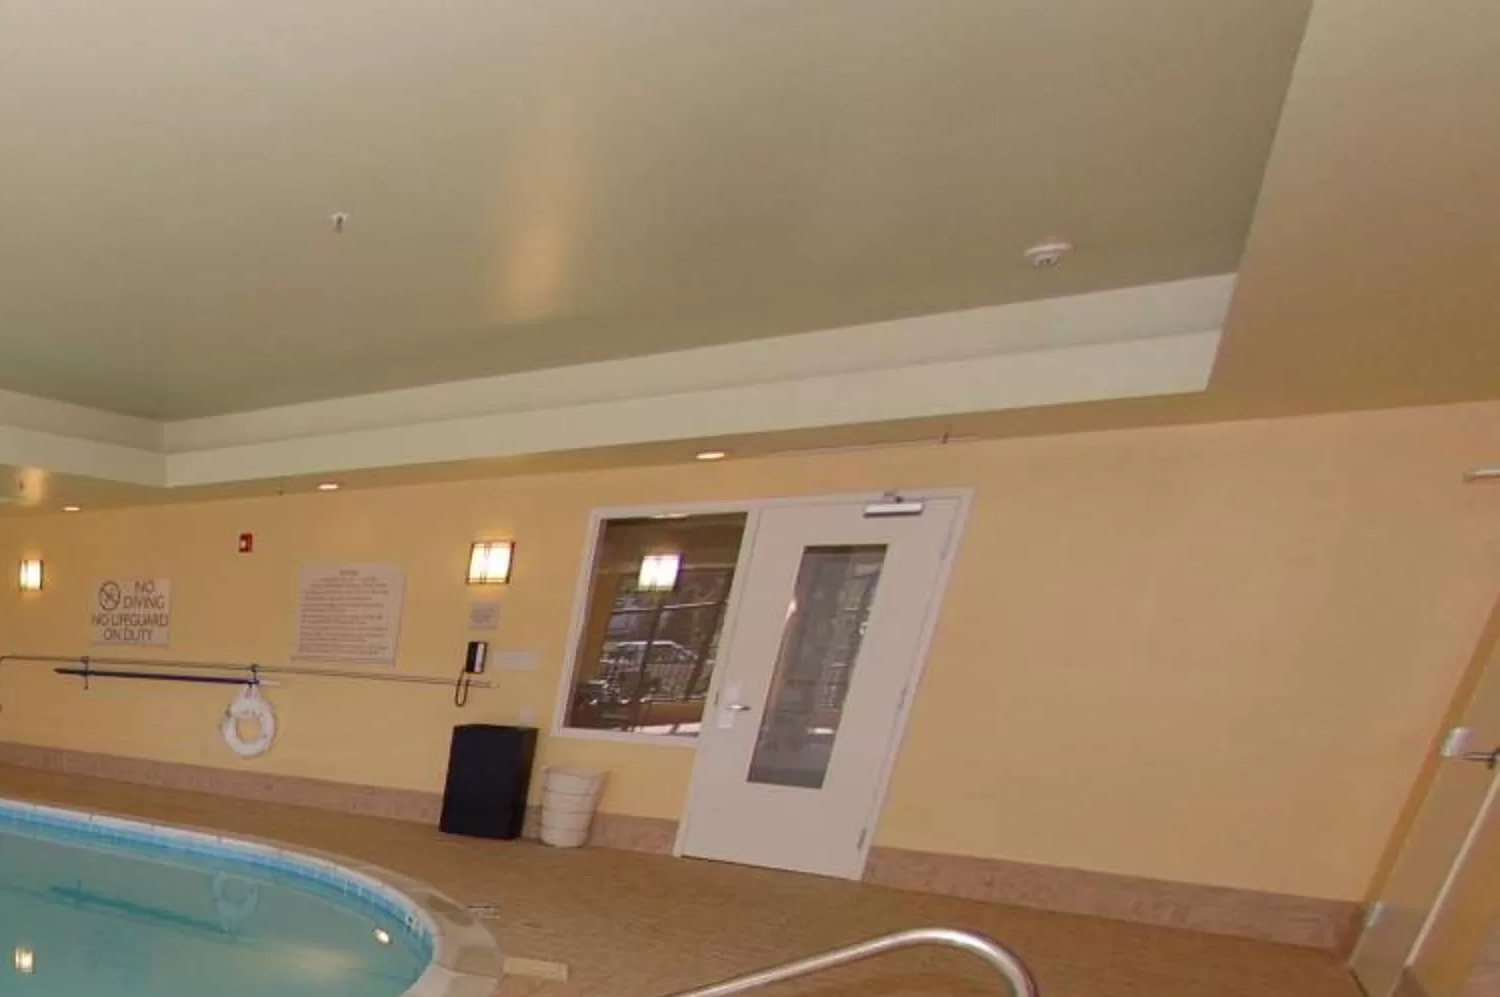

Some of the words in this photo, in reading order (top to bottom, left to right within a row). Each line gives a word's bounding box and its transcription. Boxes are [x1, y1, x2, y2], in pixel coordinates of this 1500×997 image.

[134, 580, 155, 593] NO
[123, 594, 165, 609] DIVING
[92, 613, 109, 626] NO
[103, 627, 121, 641] ON
[123, 627, 153, 641] DUTY
